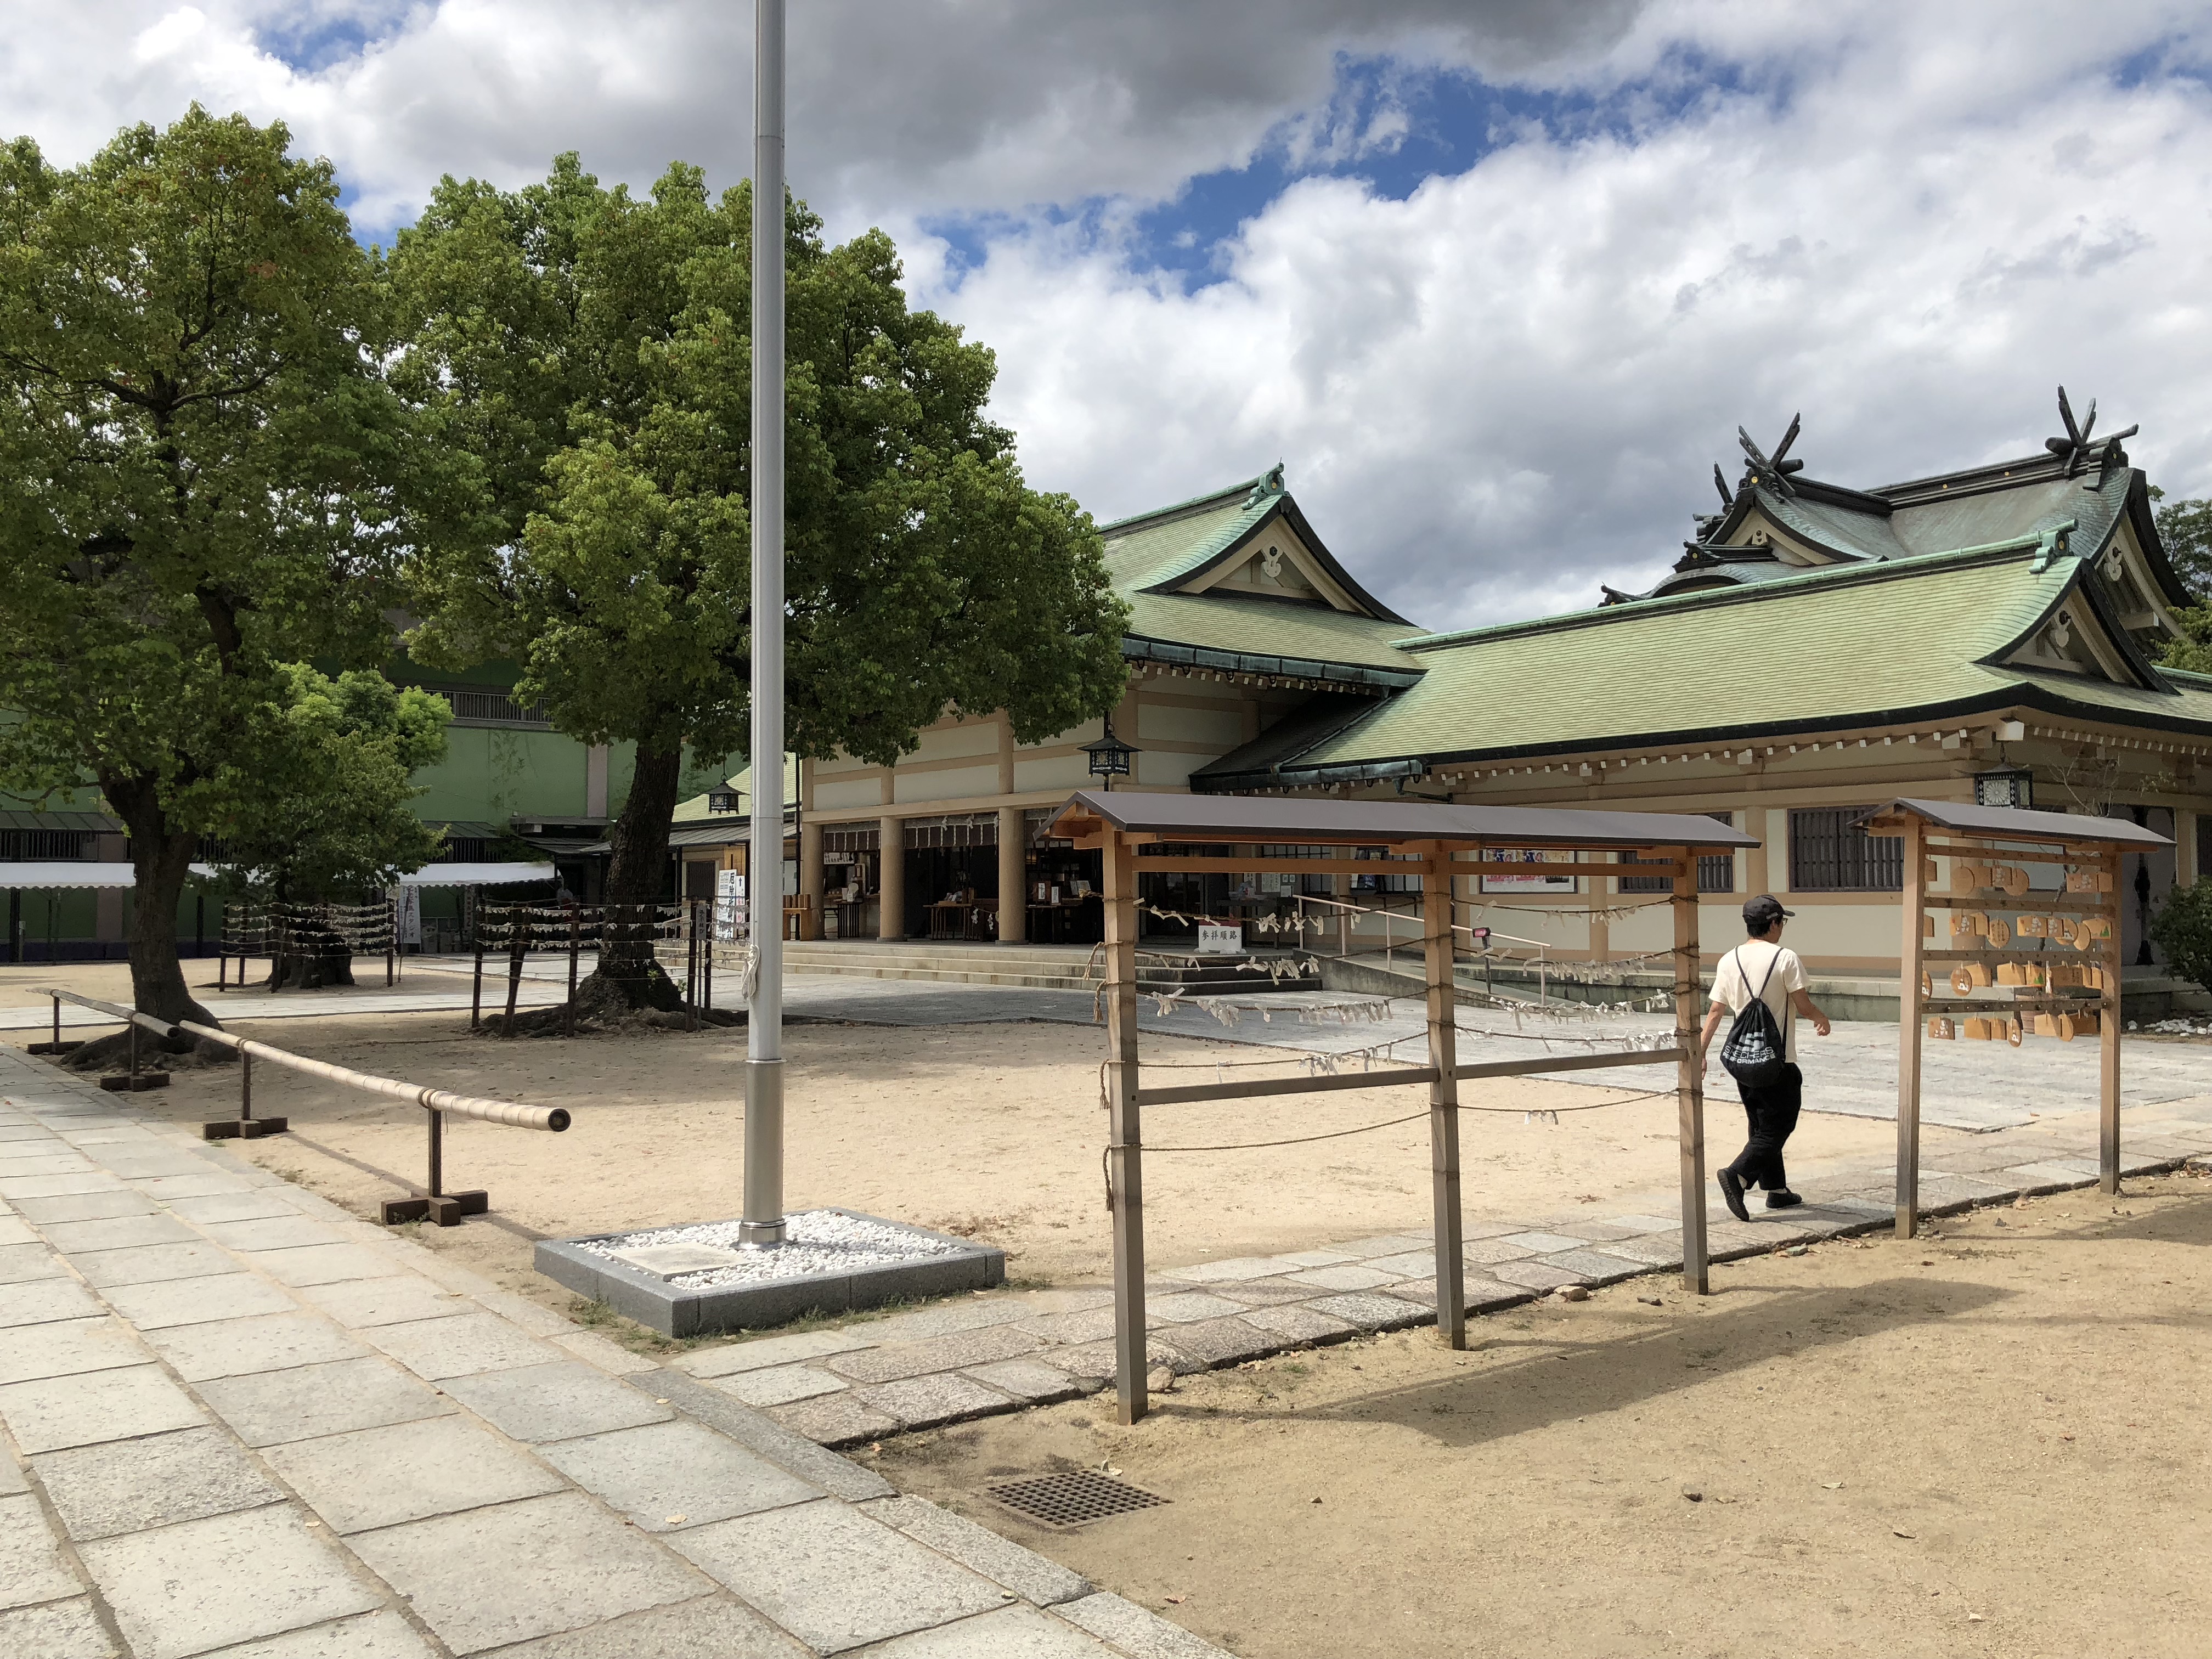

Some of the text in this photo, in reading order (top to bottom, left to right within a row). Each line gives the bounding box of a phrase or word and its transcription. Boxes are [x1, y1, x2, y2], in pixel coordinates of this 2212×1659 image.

[1202, 929, 1237, 941] 参拝順路
[1722, 1051, 1776, 1064] PERFORMANCE
[1724, 1045, 1774, 1058] SKECHERS
